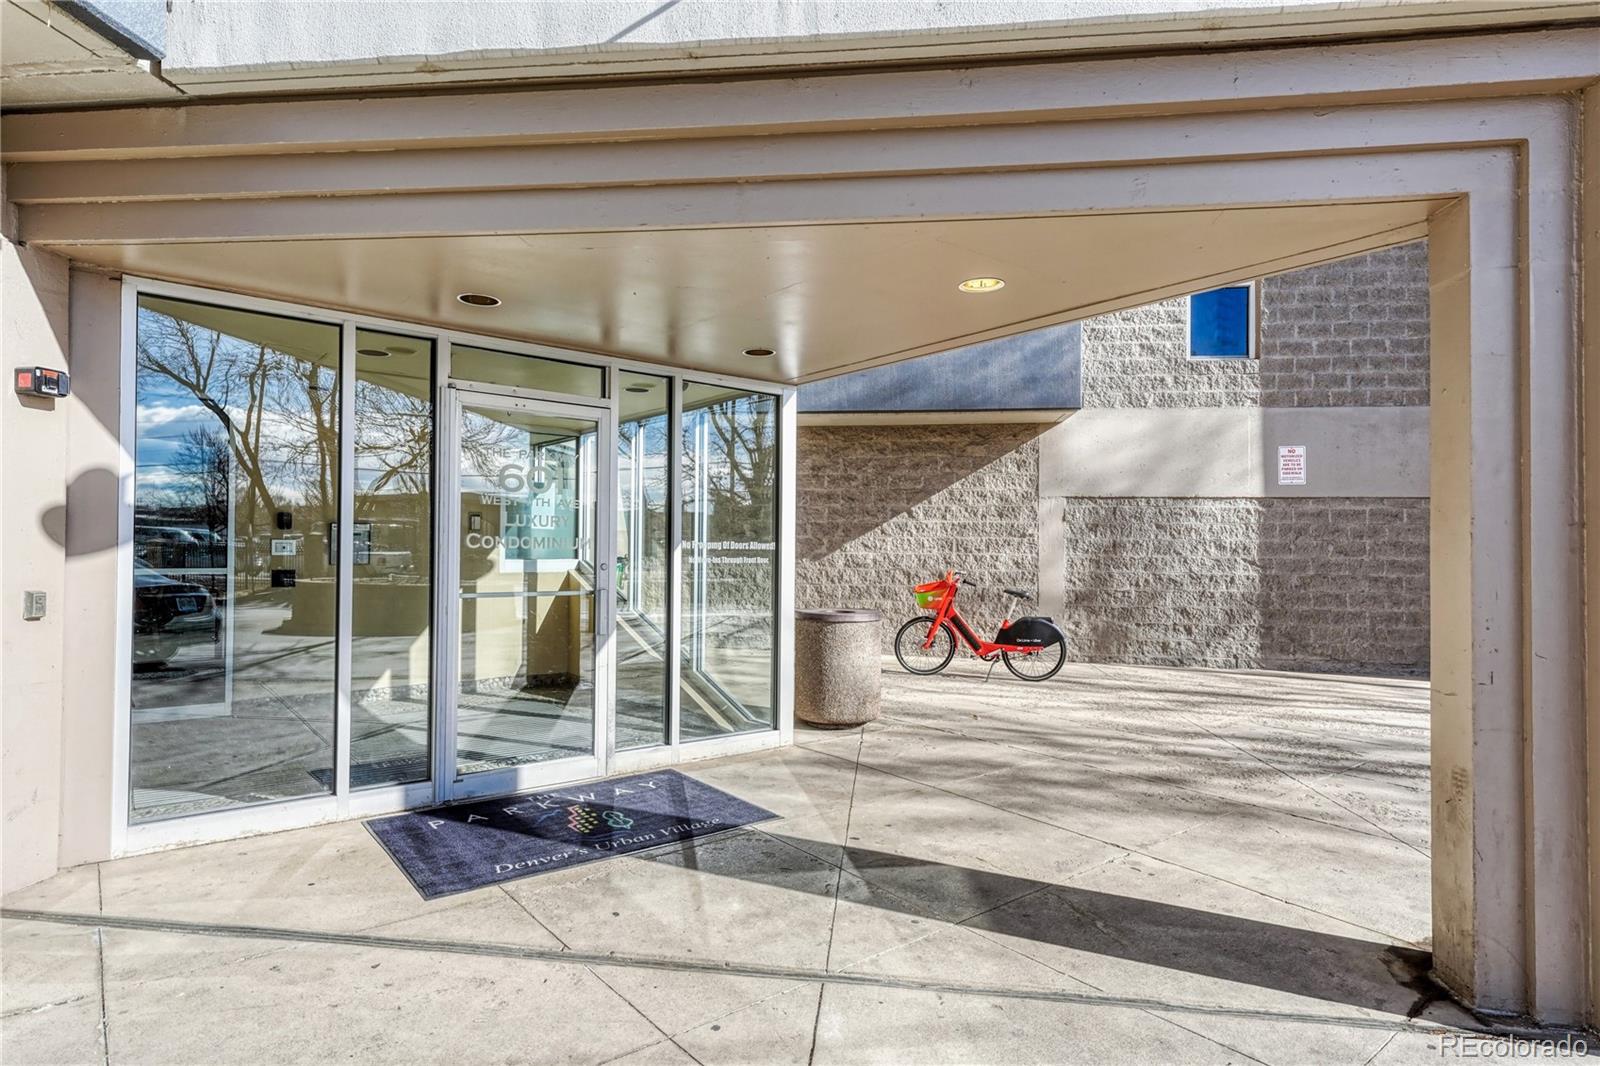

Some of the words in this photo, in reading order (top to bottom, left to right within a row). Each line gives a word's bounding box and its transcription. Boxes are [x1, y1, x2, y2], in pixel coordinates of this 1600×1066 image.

[504, 512, 569, 528] LUXURY
[466, 532, 592, 550] CONDOMINUM
[731, 541, 749, 549] Doors
[427, 780, 657, 830] PARKWAY
[528, 792, 559, 802] THE
[494, 846, 588, 874] Denver's
[594, 832, 655, 852] Urban
[659, 816, 722, 838] Village
